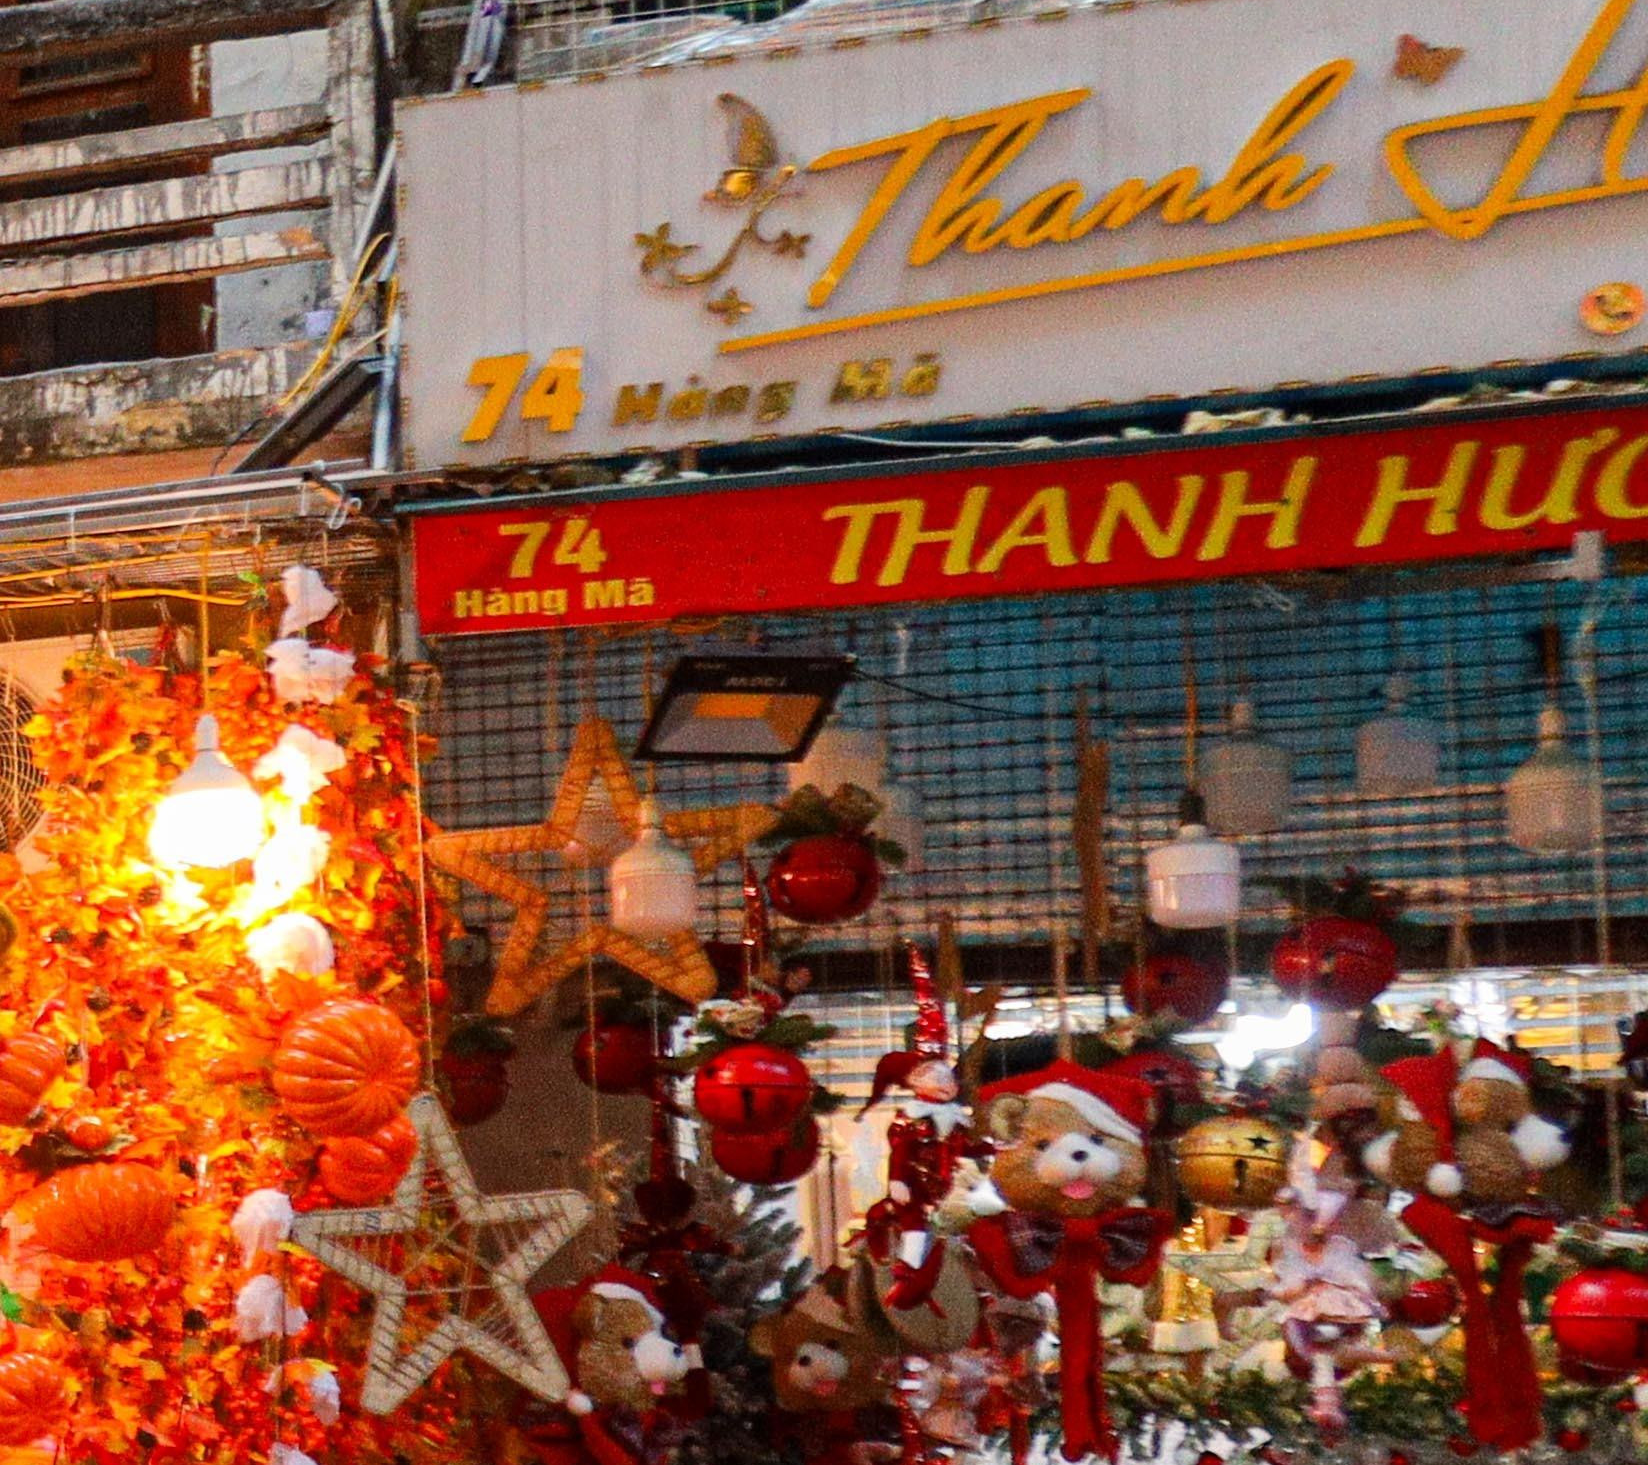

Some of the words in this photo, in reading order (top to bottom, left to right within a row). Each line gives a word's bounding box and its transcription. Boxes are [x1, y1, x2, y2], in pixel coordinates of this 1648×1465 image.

[806, 58, 1356, 310] Thanh
[462, 346, 585, 443] 74
[498, 518, 608, 579] 74
[822, 455, 1318, 587] THANH
[454, 586, 568, 619] Hàng
[582, 577, 656, 611] Mã
